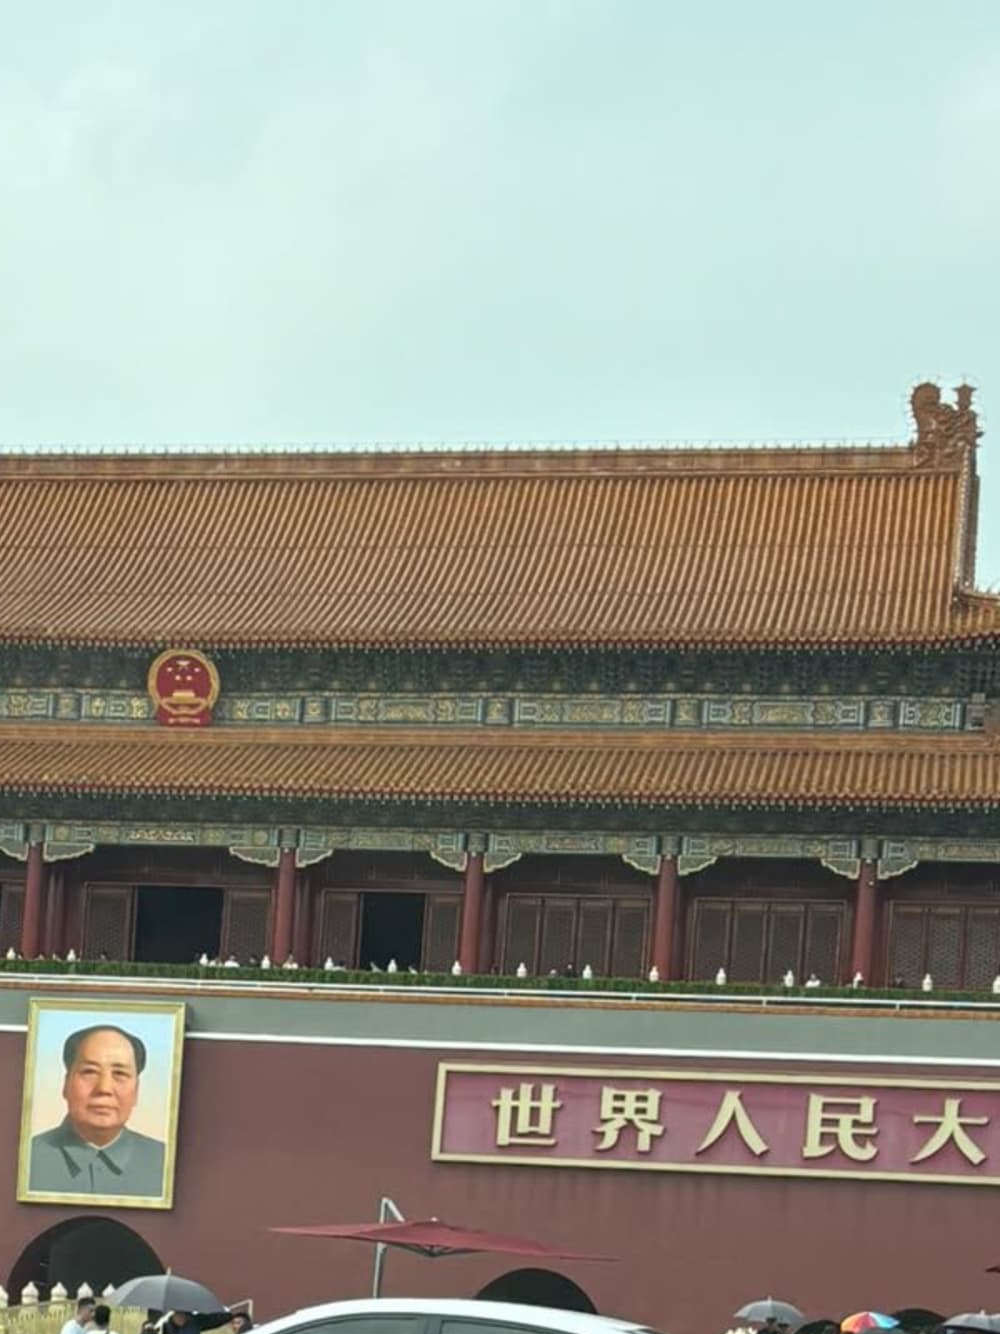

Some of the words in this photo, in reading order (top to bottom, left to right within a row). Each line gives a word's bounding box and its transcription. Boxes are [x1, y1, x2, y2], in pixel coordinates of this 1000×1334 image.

[491, 1083, 989, 1166] 世界人民大
